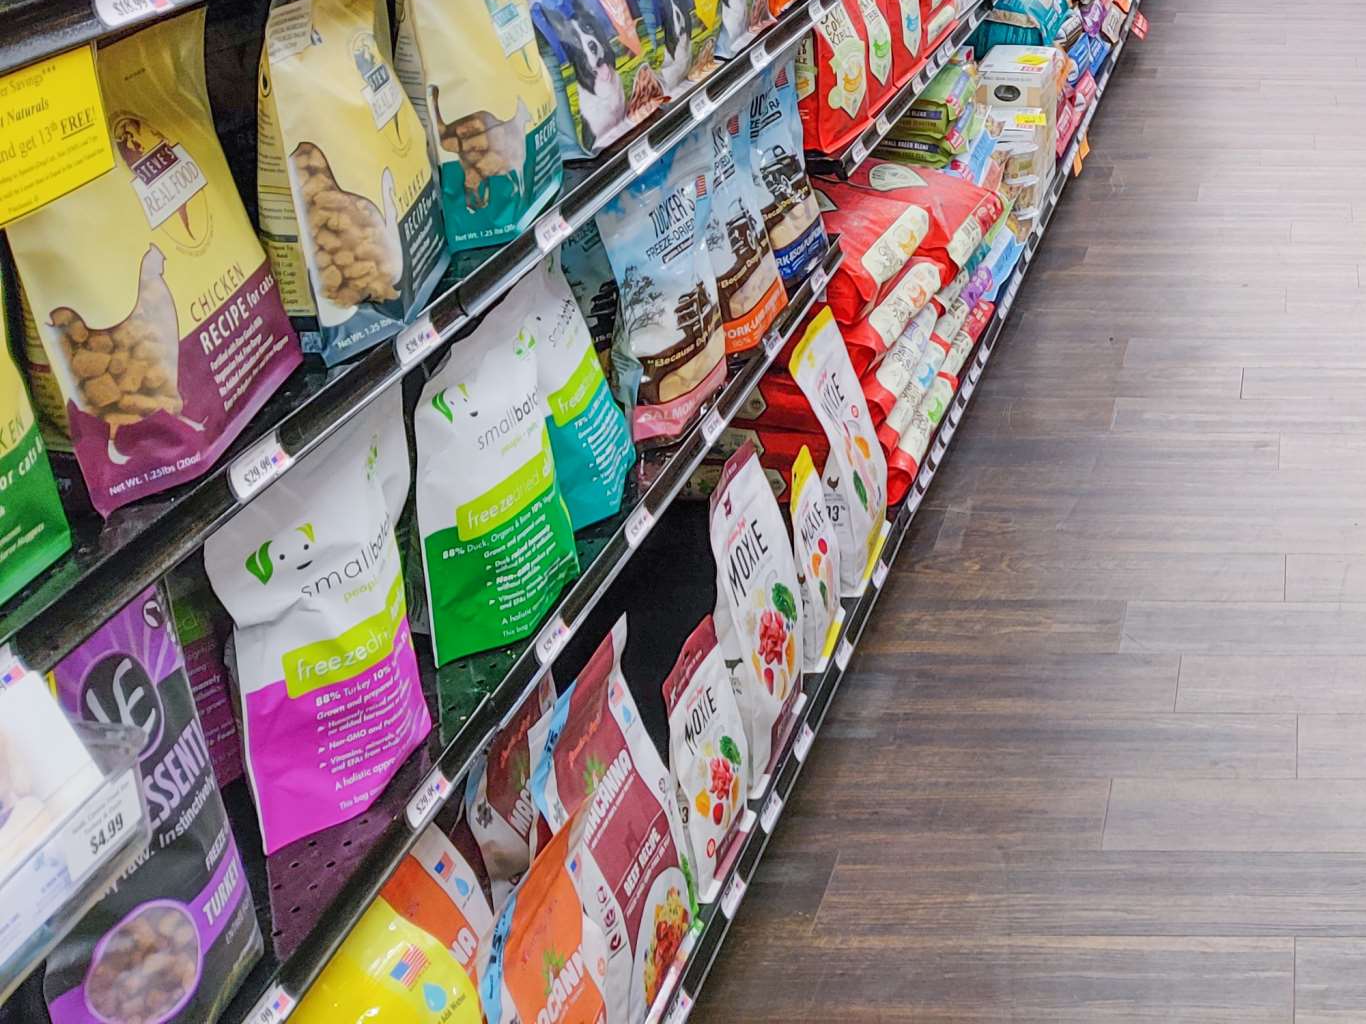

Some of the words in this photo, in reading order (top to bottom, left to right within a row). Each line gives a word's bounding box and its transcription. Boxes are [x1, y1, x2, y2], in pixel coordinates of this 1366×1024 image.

[7, 97, 50, 123] Naturals
[18, 136, 37, 158] get
[60, 106, 98, 135] FREE!
[136, 143, 176, 183] STEVE'S
[143, 177, 177, 216] REAL
[173, 160, 200, 196] FOOD
[648, 187, 697, 237] TUCKER'S
[189, 262, 246, 323] CHICKEN
[200, 295, 251, 356] RECIPE
[246, 288, 261, 309] for
[258, 273, 276, 295] cats
[109, 482, 126, 497] Net
[125, 477, 143, 493] Wt.
[727, 519, 770, 608] MOXIE
[314, 689, 342, 709] 88%
[342, 679, 373, 702] Turkey
[372, 665, 393, 685] 10%
[316, 705, 345, 721] Grown
[683, 686, 718, 756] MOXIE
[339, 799, 353, 811] This
[353, 791, 369, 807] bag
[342, 768, 371, 788] holistic
[89, 812, 125, 855] $4.99
[202, 856, 241, 925] TURKEY
